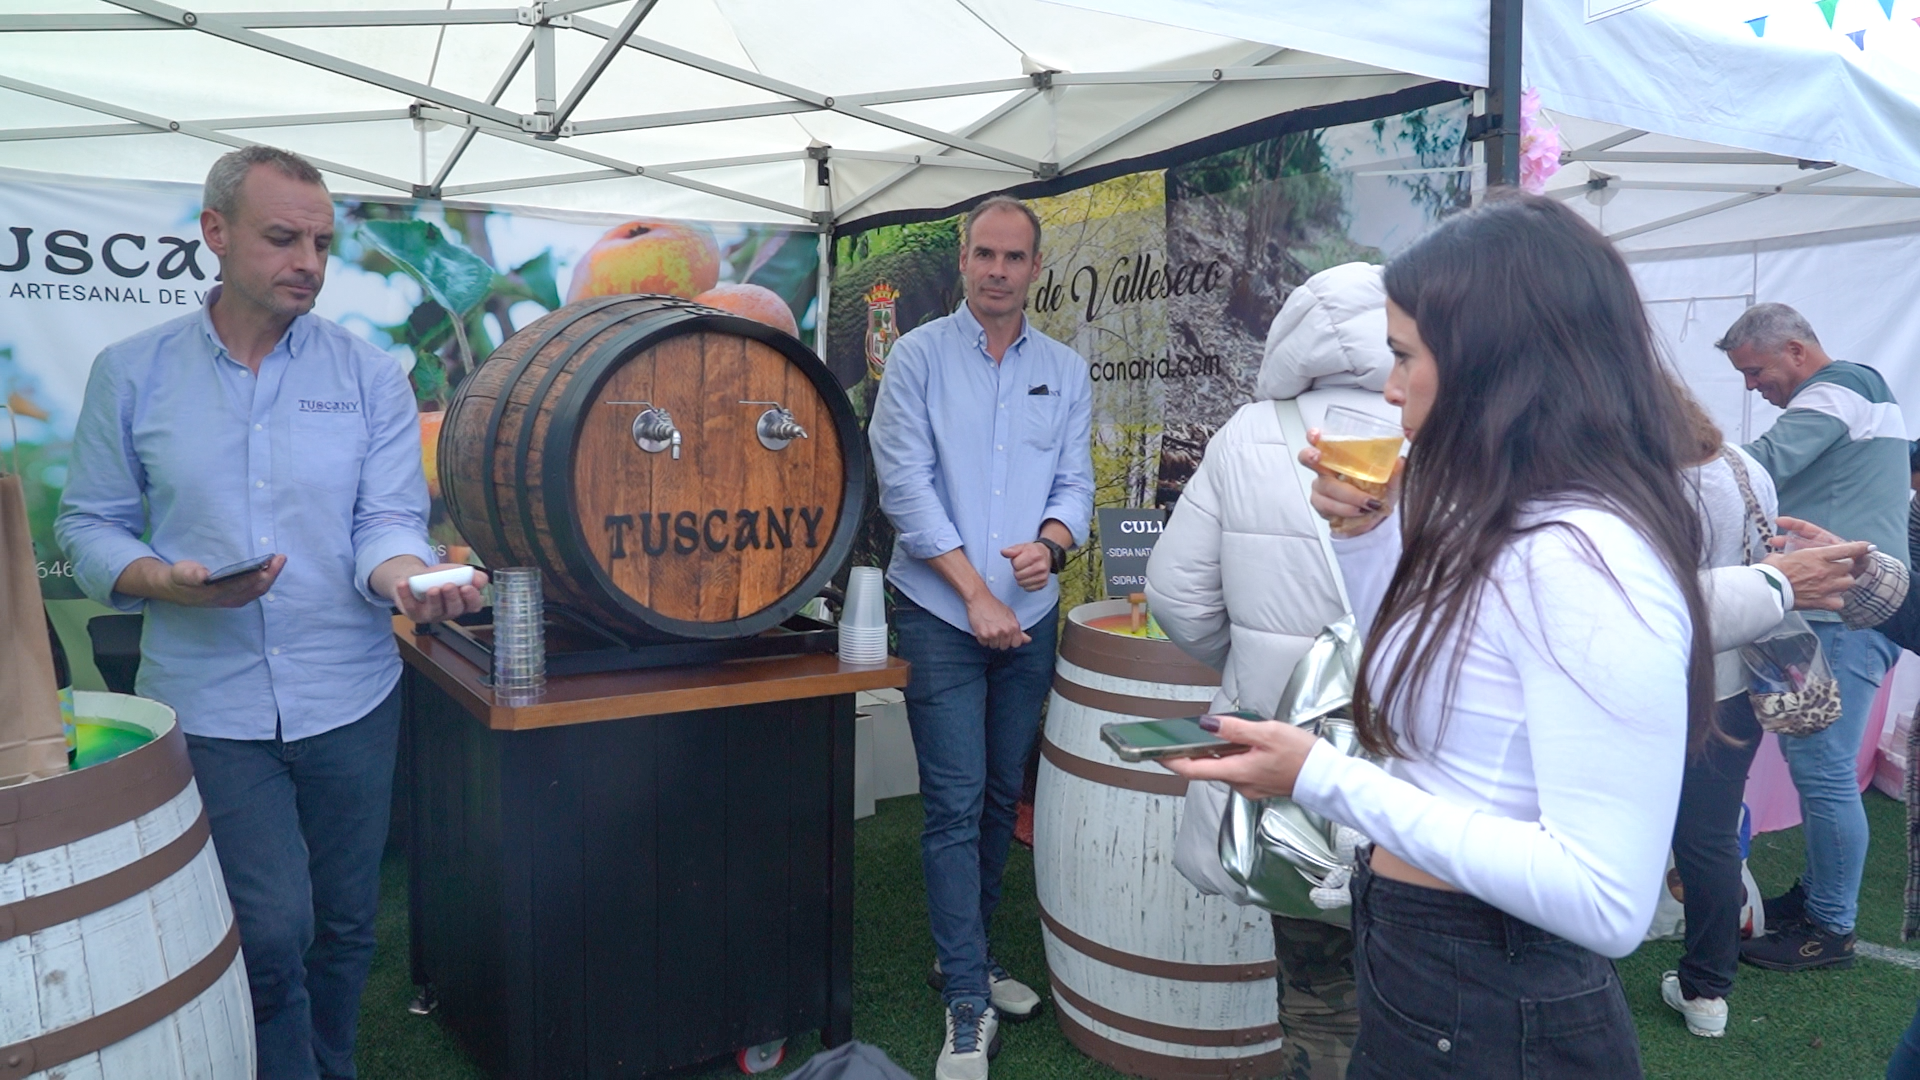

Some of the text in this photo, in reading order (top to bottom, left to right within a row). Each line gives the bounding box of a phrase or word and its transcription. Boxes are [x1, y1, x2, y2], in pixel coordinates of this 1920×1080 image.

[9, 282, 208, 306] ARTESANAL DE V
[1035, 253, 1224, 323] de Valleseco
[1089, 349, 1221, 382] canaria.com
[1135, 547, 1152, 558] NAT
